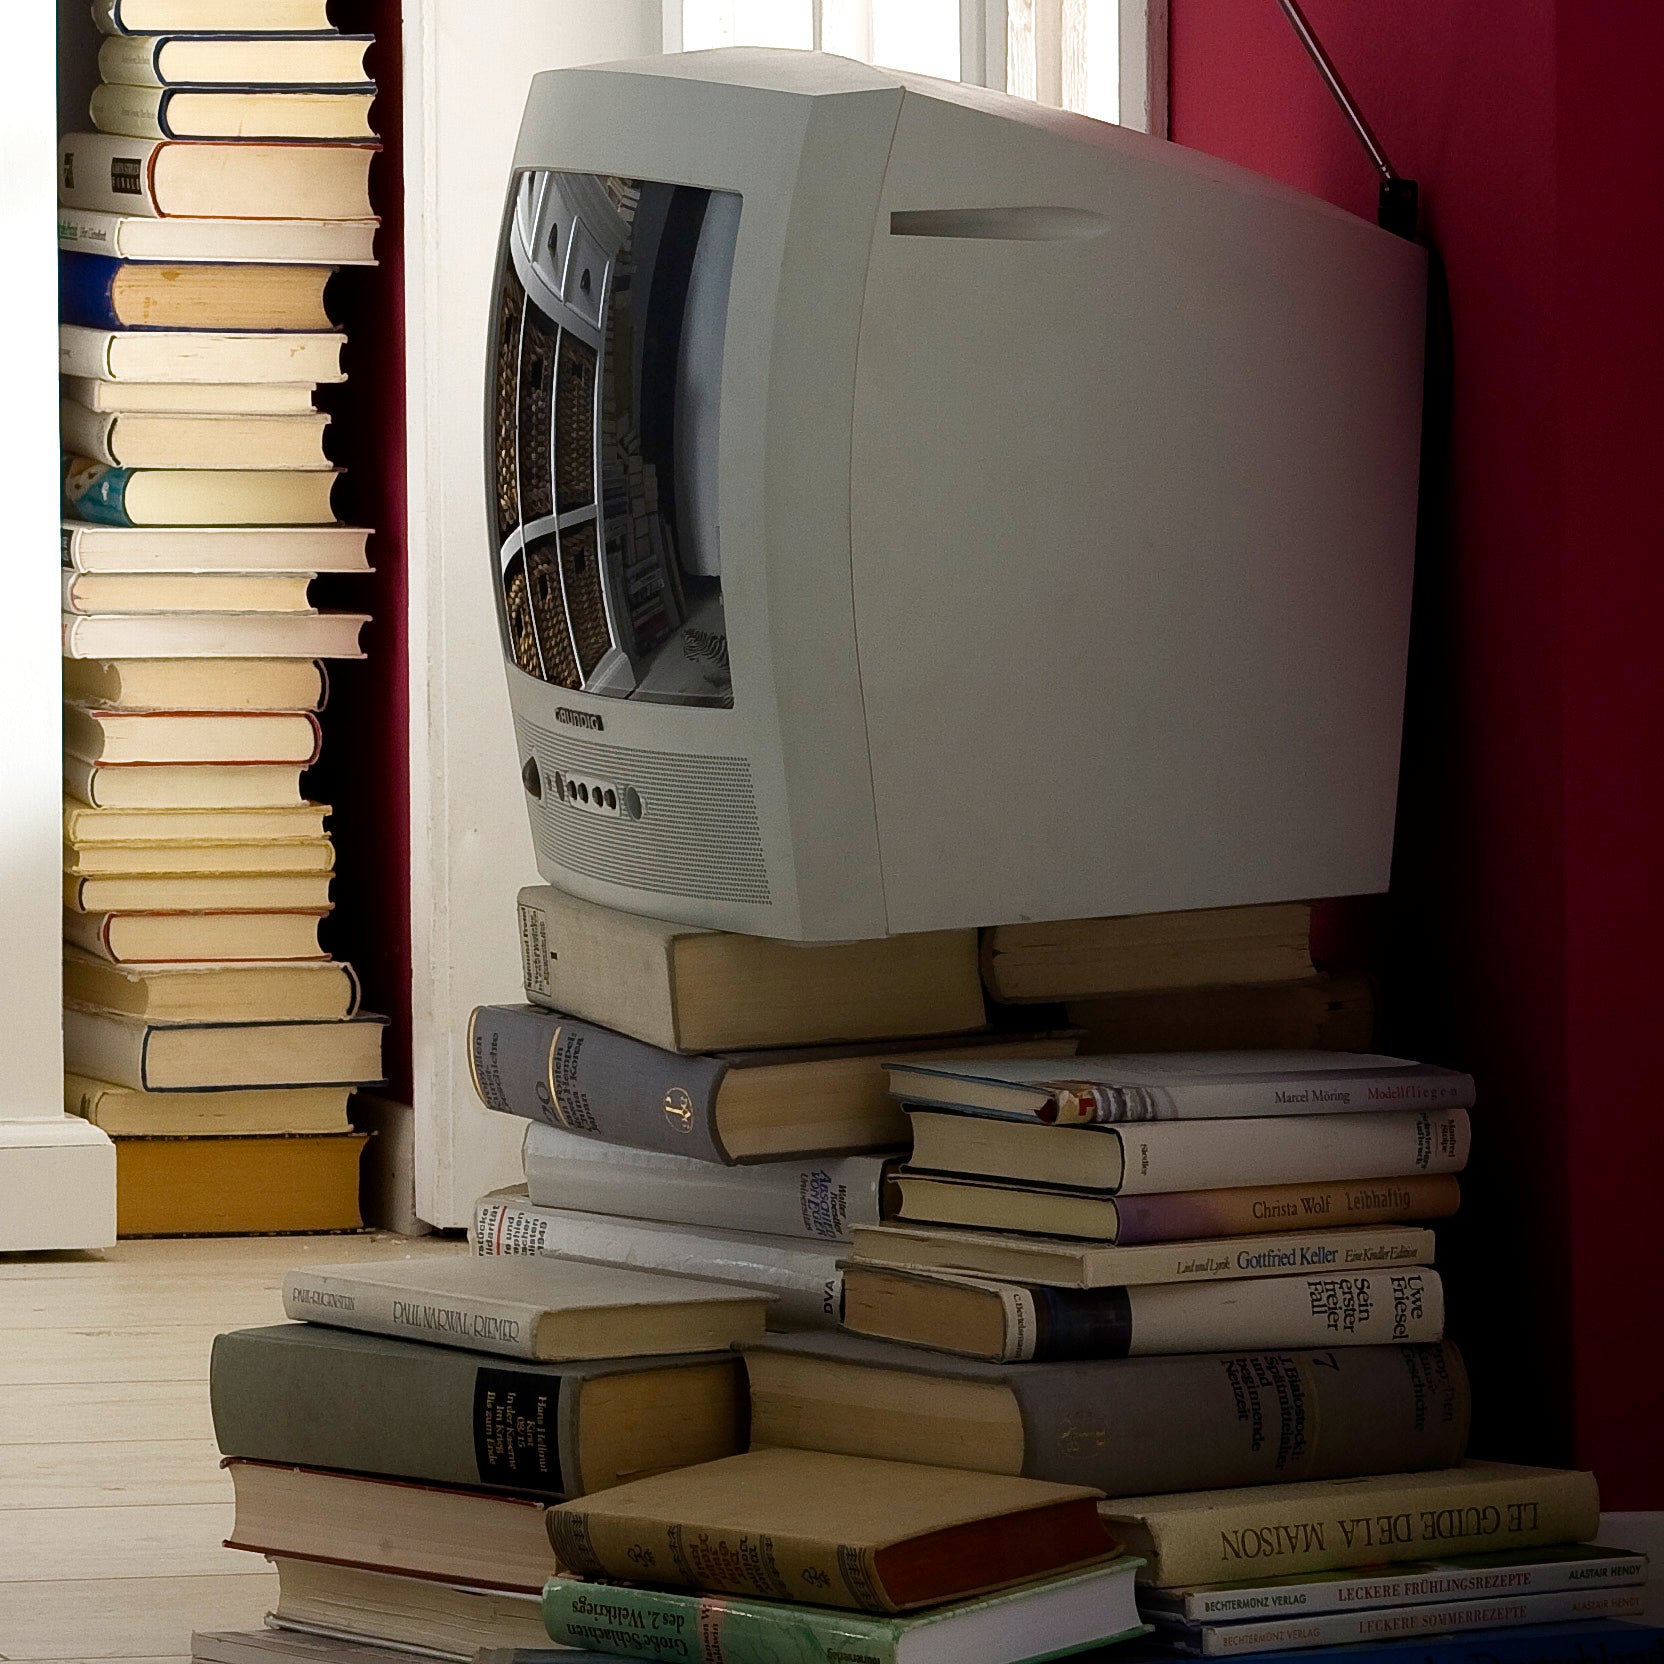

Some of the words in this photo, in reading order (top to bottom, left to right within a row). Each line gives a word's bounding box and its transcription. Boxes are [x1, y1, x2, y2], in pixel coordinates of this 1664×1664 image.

[1237, 1250, 1296, 1270] Gottfried
[1300, 1248, 1338, 1265] Keller
[1307, 1281, 1327, 1316] Fall
[1324, 1281, 1340, 1331] freier
[1339, 1279, 1354, 1332] erster
[1354, 1279, 1373, 1322] Sein
[1391, 1277, 1409, 1340] Friesel
[1408, 1275, 1423, 1319] Uwe
[1337, 1519, 1373, 1547] LA
[1377, 1514, 1412, 1545] DE
[1422, 1507, 1501, 1539] GUIDE
[1508, 1502, 1539, 1532] LE
[1221, 1523, 1326, 1560] MAISON
[1338, 1585, 1401, 1602] LECKERE
[1405, 1572, 1531, 1597] FRÜHLINGSREZEPTE
